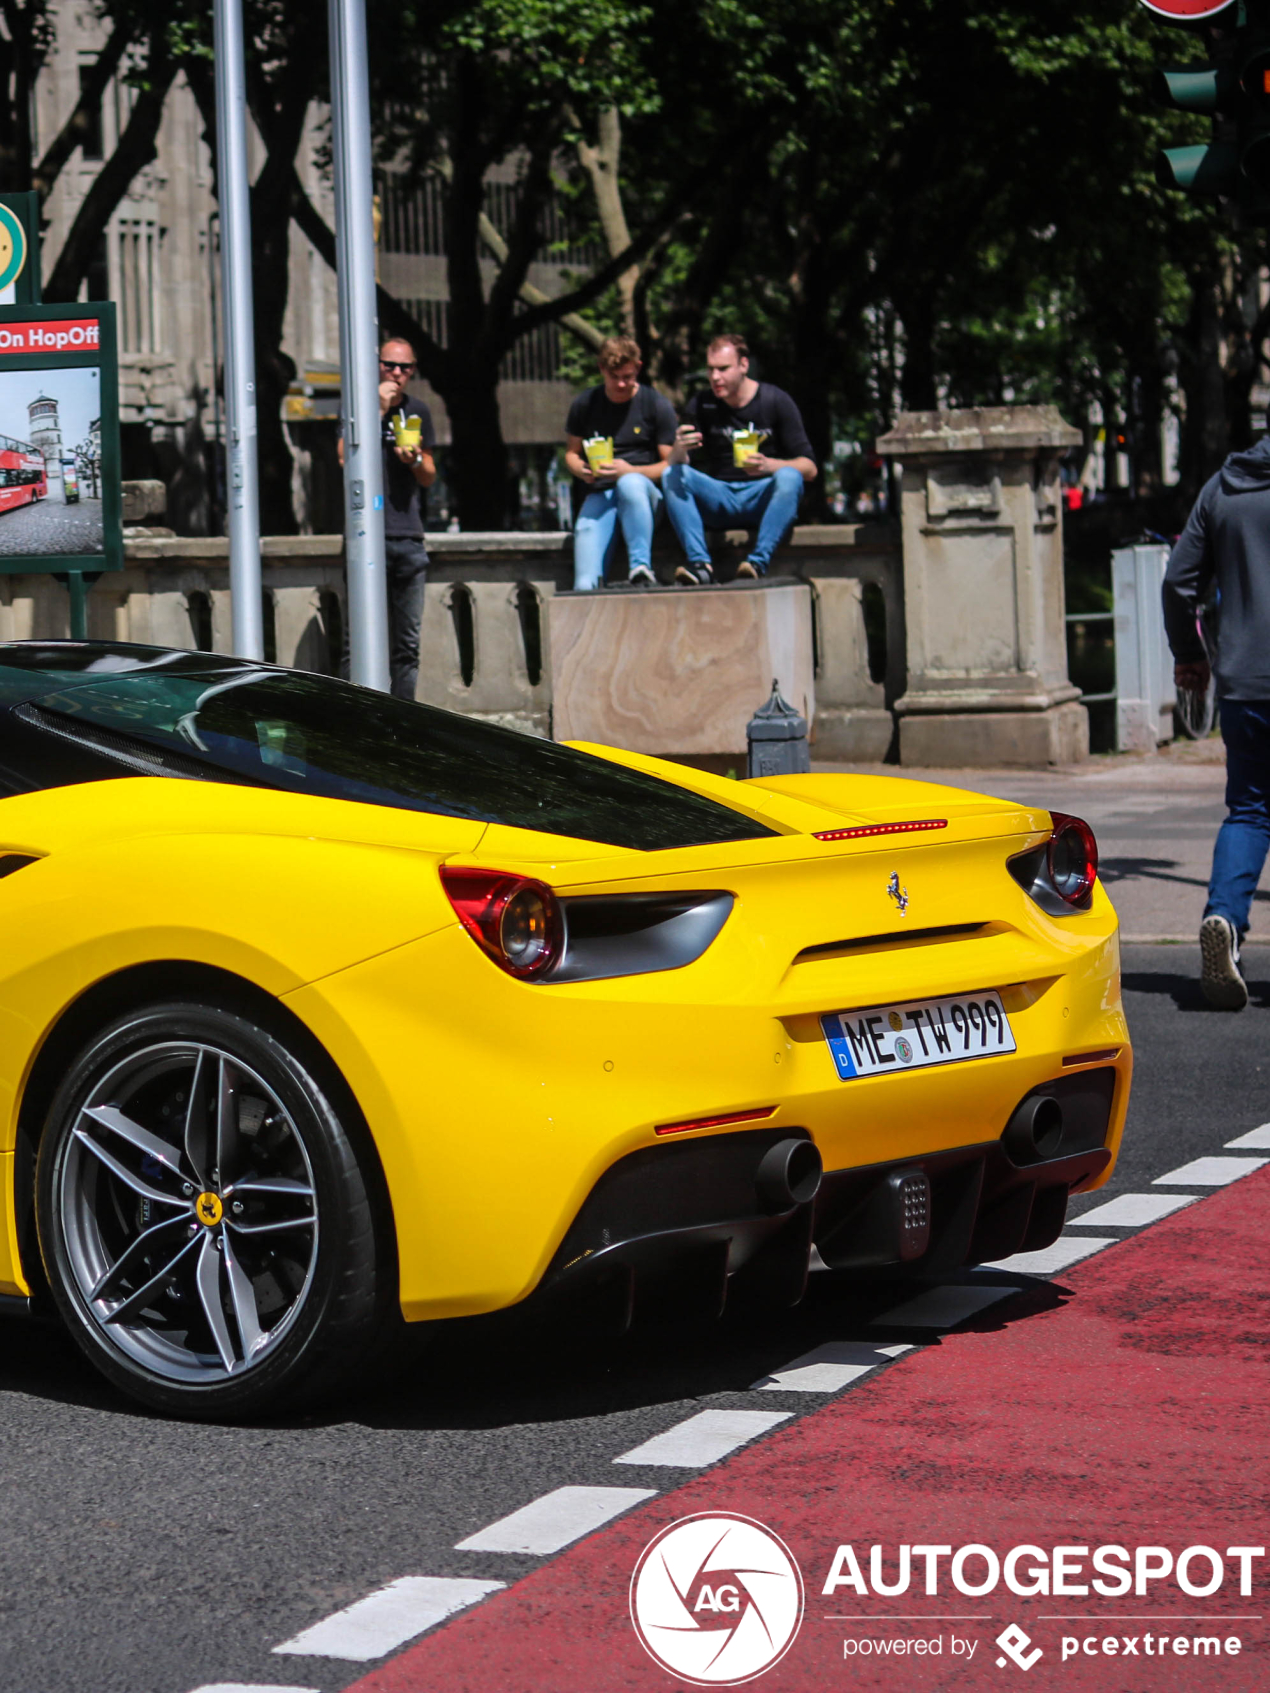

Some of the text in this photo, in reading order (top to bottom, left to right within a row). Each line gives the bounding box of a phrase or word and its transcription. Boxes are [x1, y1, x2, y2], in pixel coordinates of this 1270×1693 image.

[29, 326, 99, 348] HopOff
[845, 999, 1004, 1067] ME TW 999
[839, 1053, 849, 1067] D
